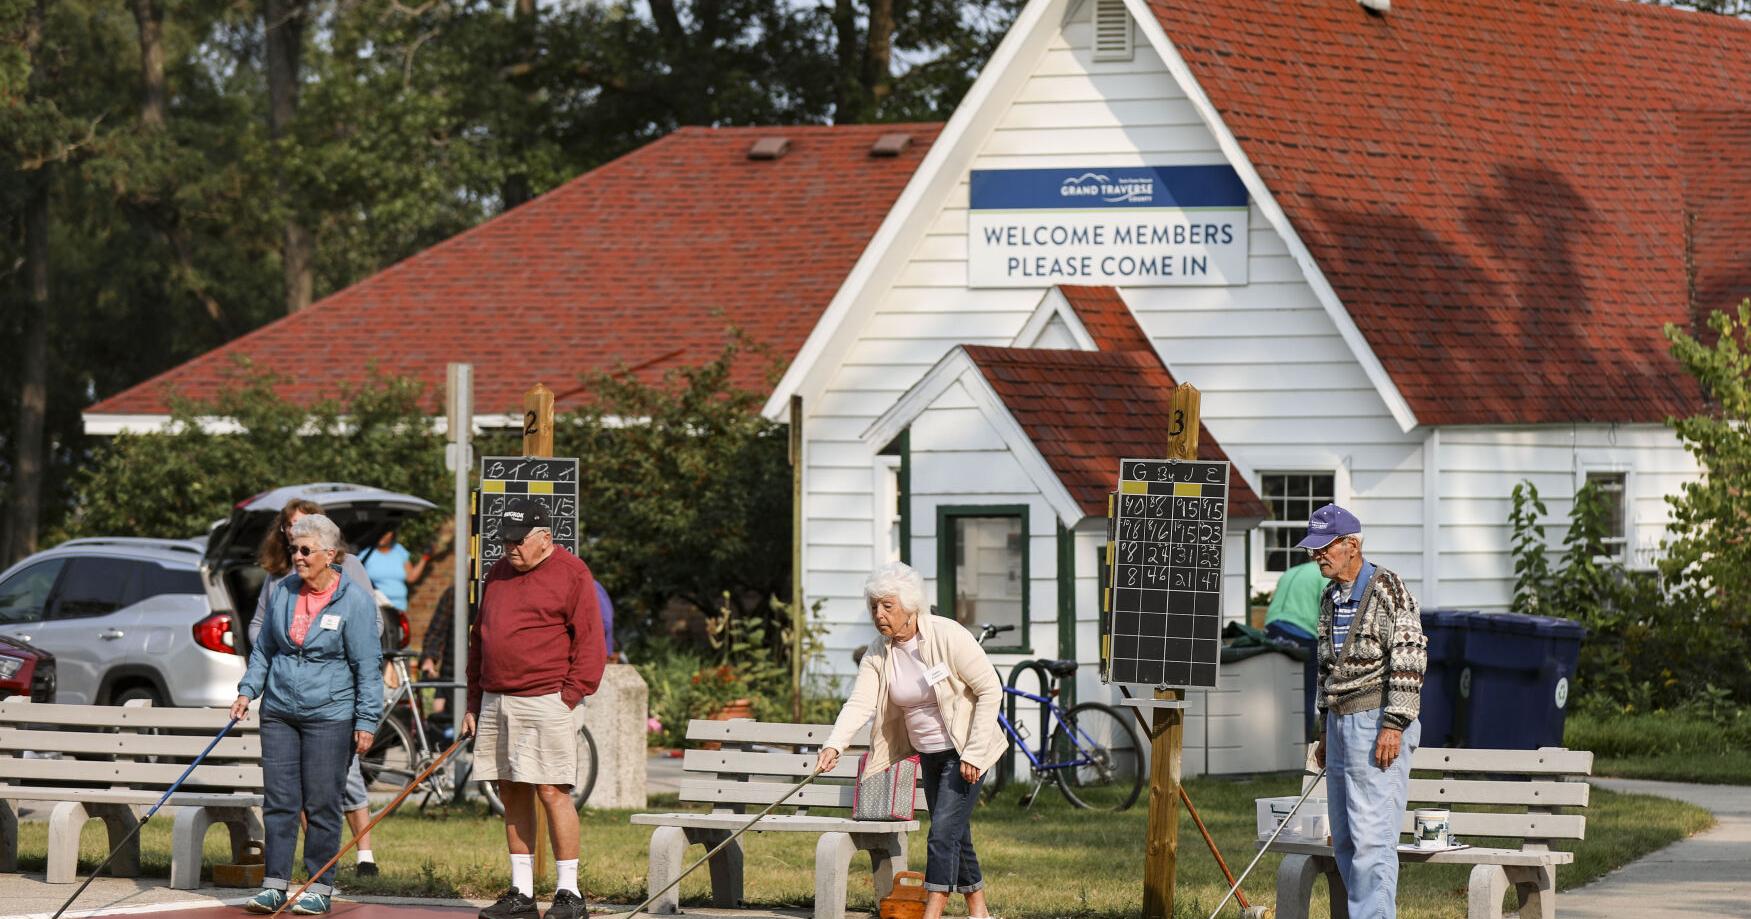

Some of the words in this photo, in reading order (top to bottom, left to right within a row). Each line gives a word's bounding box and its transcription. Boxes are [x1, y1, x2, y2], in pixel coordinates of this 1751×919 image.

[1060, 184, 1099, 197] GRAND
[1101, 183, 1154, 195] TRAVERSE
[983, 225, 1105, 246] WELCOME
[1113, 223, 1233, 245] MEMBERS
[1007, 256, 1093, 277] PLEASE
[1100, 255, 1173, 276] COME
[1182, 255, 1208, 276] IN
[524, 410, 538, 436] 2
[1169, 408, 1185, 436] 3
[488, 461, 505, 478] B
[508, 462, 527, 482] T
[1132, 462, 1147, 481] G
[1183, 466, 1194, 482] J
[553, 498, 575, 516] 15
[1127, 567, 1138, 586] 8
[1147, 566, 1167, 585] 46
[1175, 571, 1192, 588] 21
[1201, 571, 1219, 590] 47
